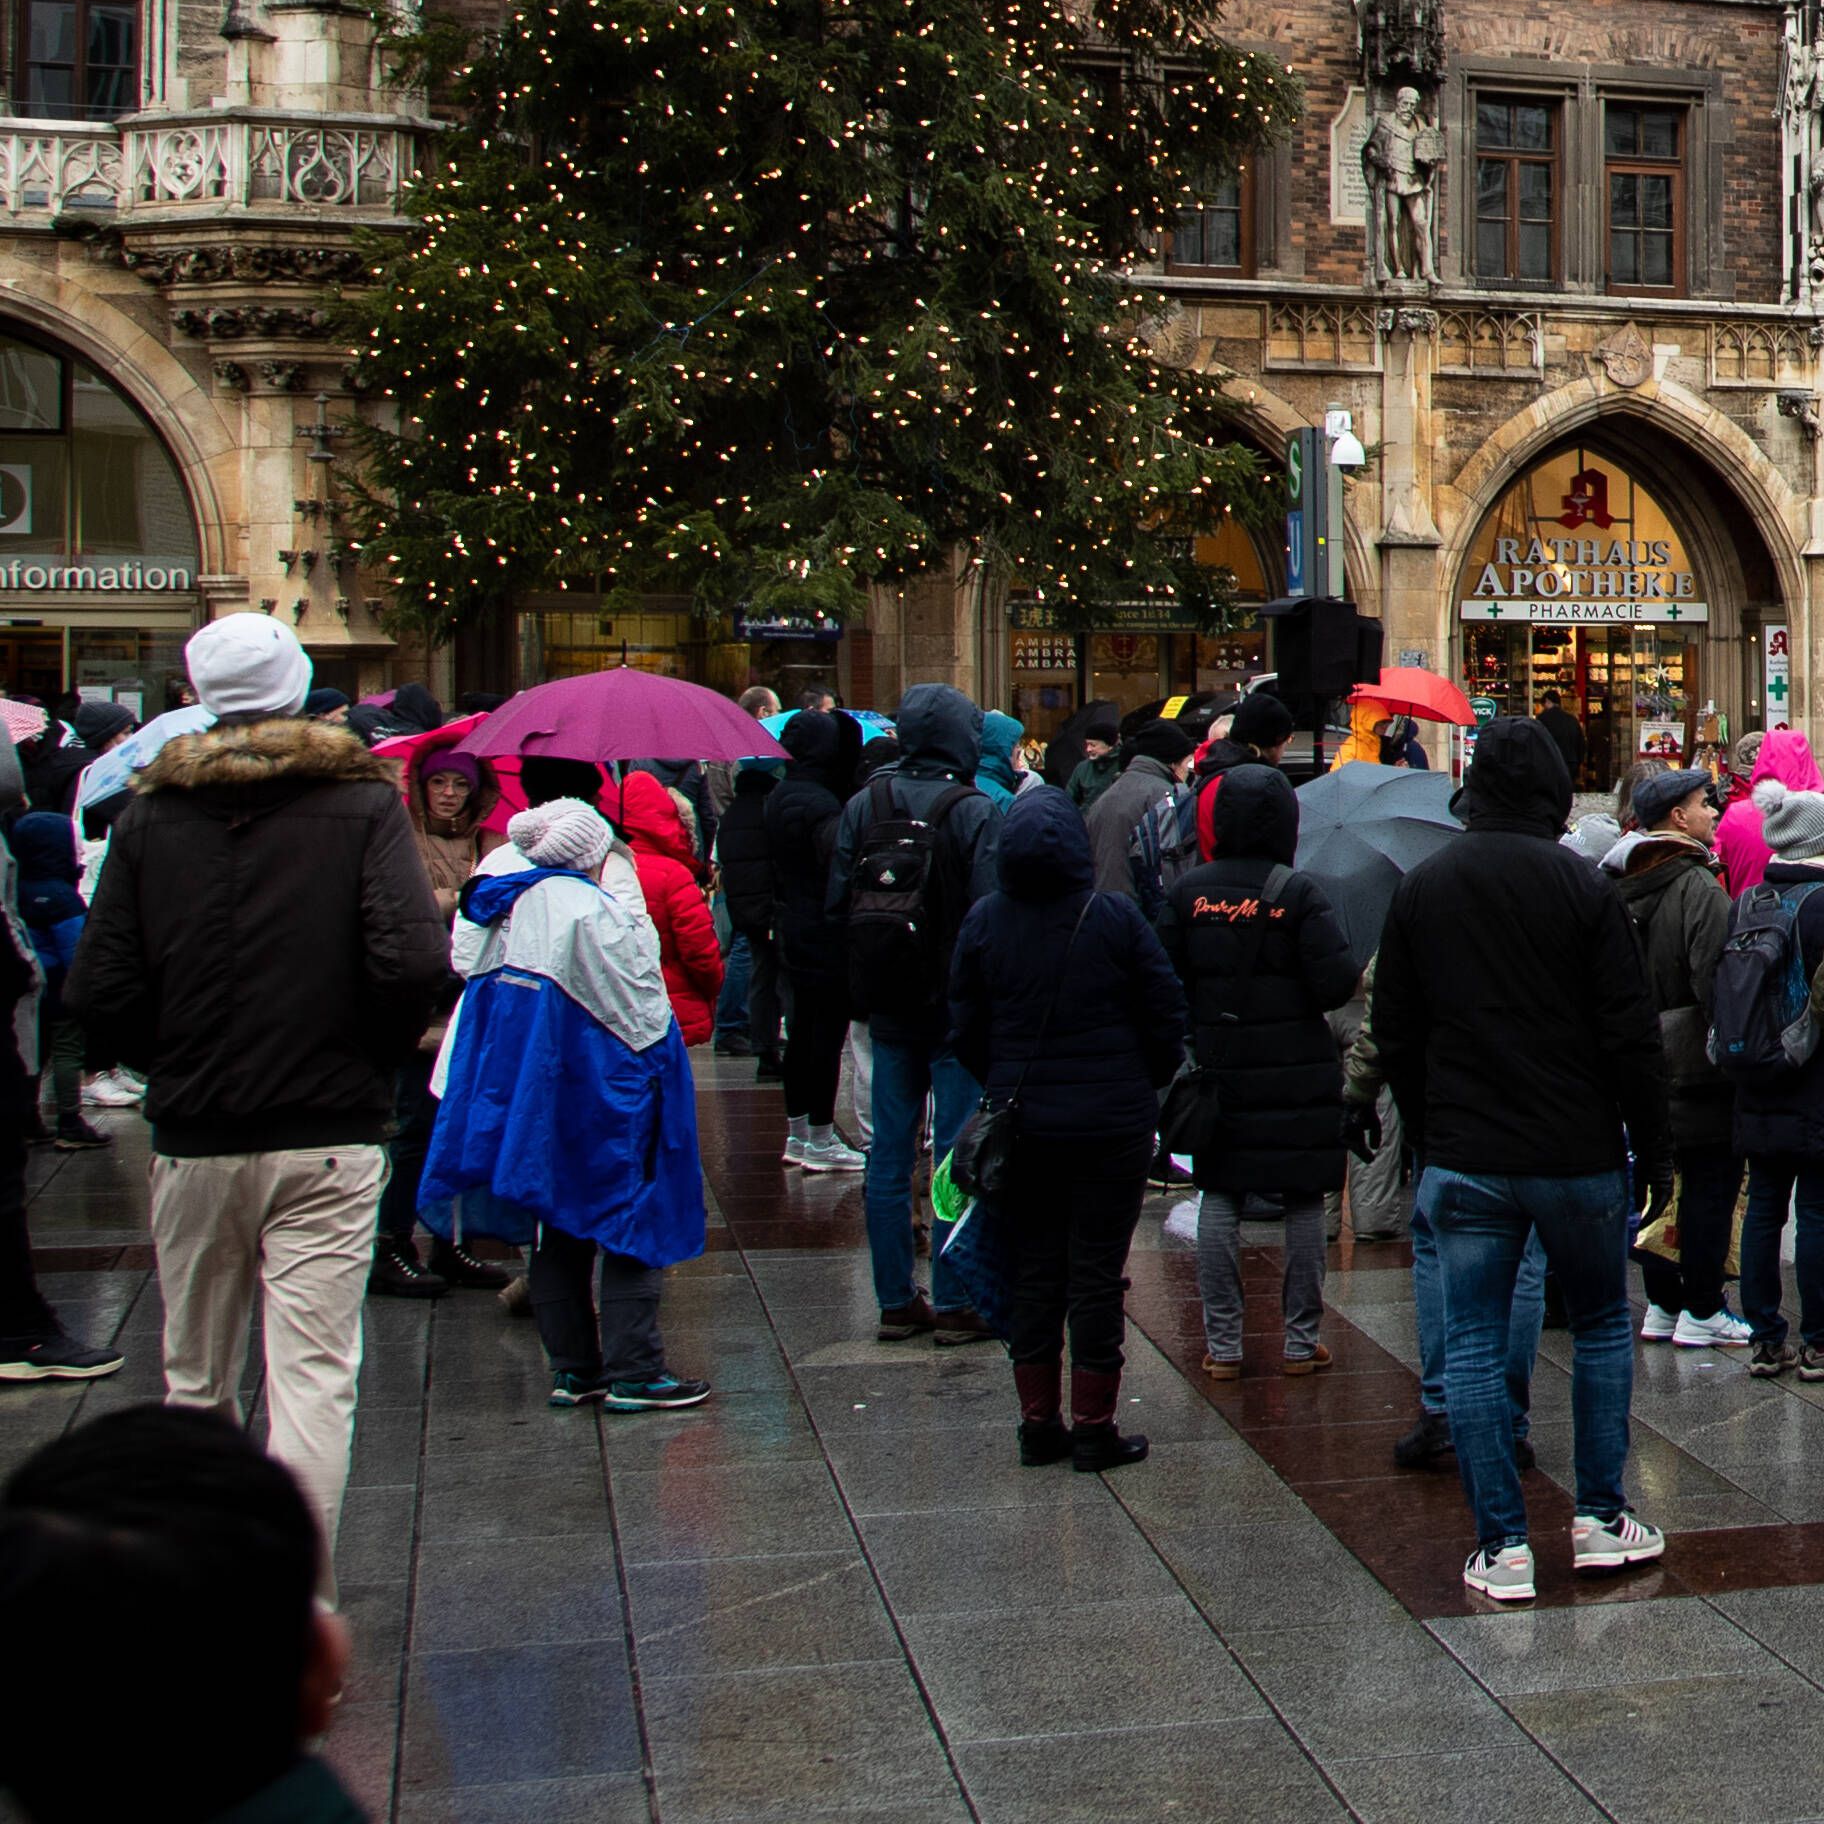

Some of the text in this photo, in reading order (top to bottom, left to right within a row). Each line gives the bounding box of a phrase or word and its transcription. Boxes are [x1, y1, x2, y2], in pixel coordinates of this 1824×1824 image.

[1289, 440, 1301, 499] S
[1290, 520, 1300, 577] U
[1495, 537, 1672, 567] RATHAUS
[0, 559, 190, 590] formation
[1473, 562, 1696, 598] APOTHEKE
[1529, 603, 1643, 619] PHARMACIE
[1015, 638, 1075, 647] AMBRE
[1015, 649, 1077, 657] AMBRA
[1015, 659, 1077, 668] AMBAR
